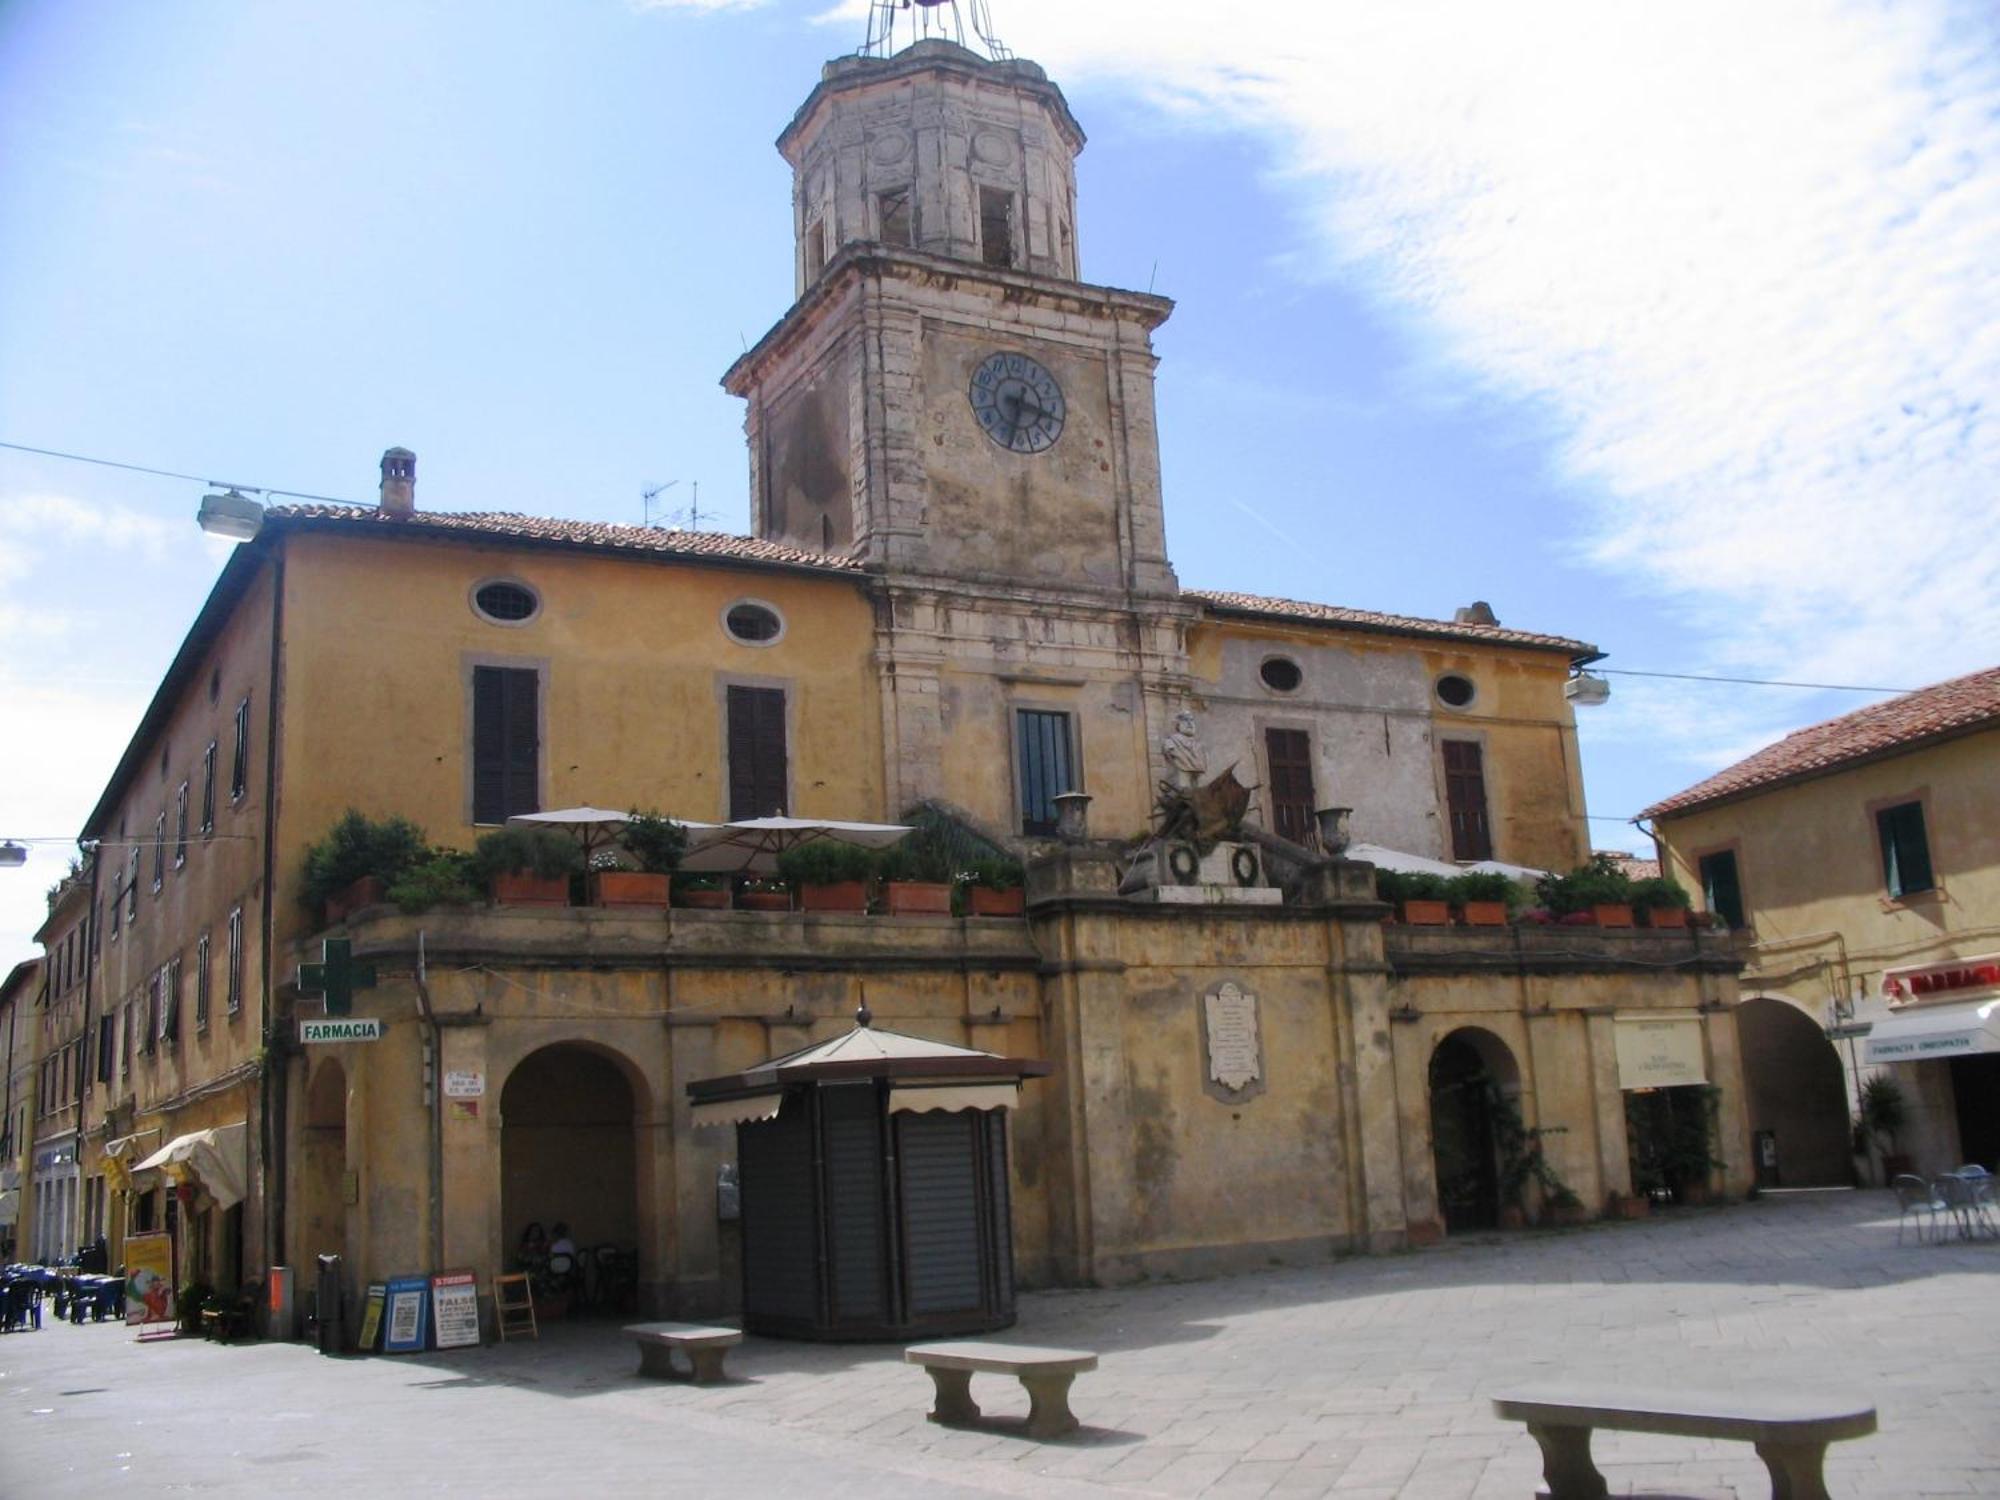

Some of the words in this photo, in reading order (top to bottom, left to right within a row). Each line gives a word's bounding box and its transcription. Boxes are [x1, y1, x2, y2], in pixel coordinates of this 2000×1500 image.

[1044, 382, 1052, 395] 2
[1033, 432, 1041, 446] 5
[1909, 964, 2000, 995] FARMACI
[304, 1023, 376, 1040] FARMACIA
